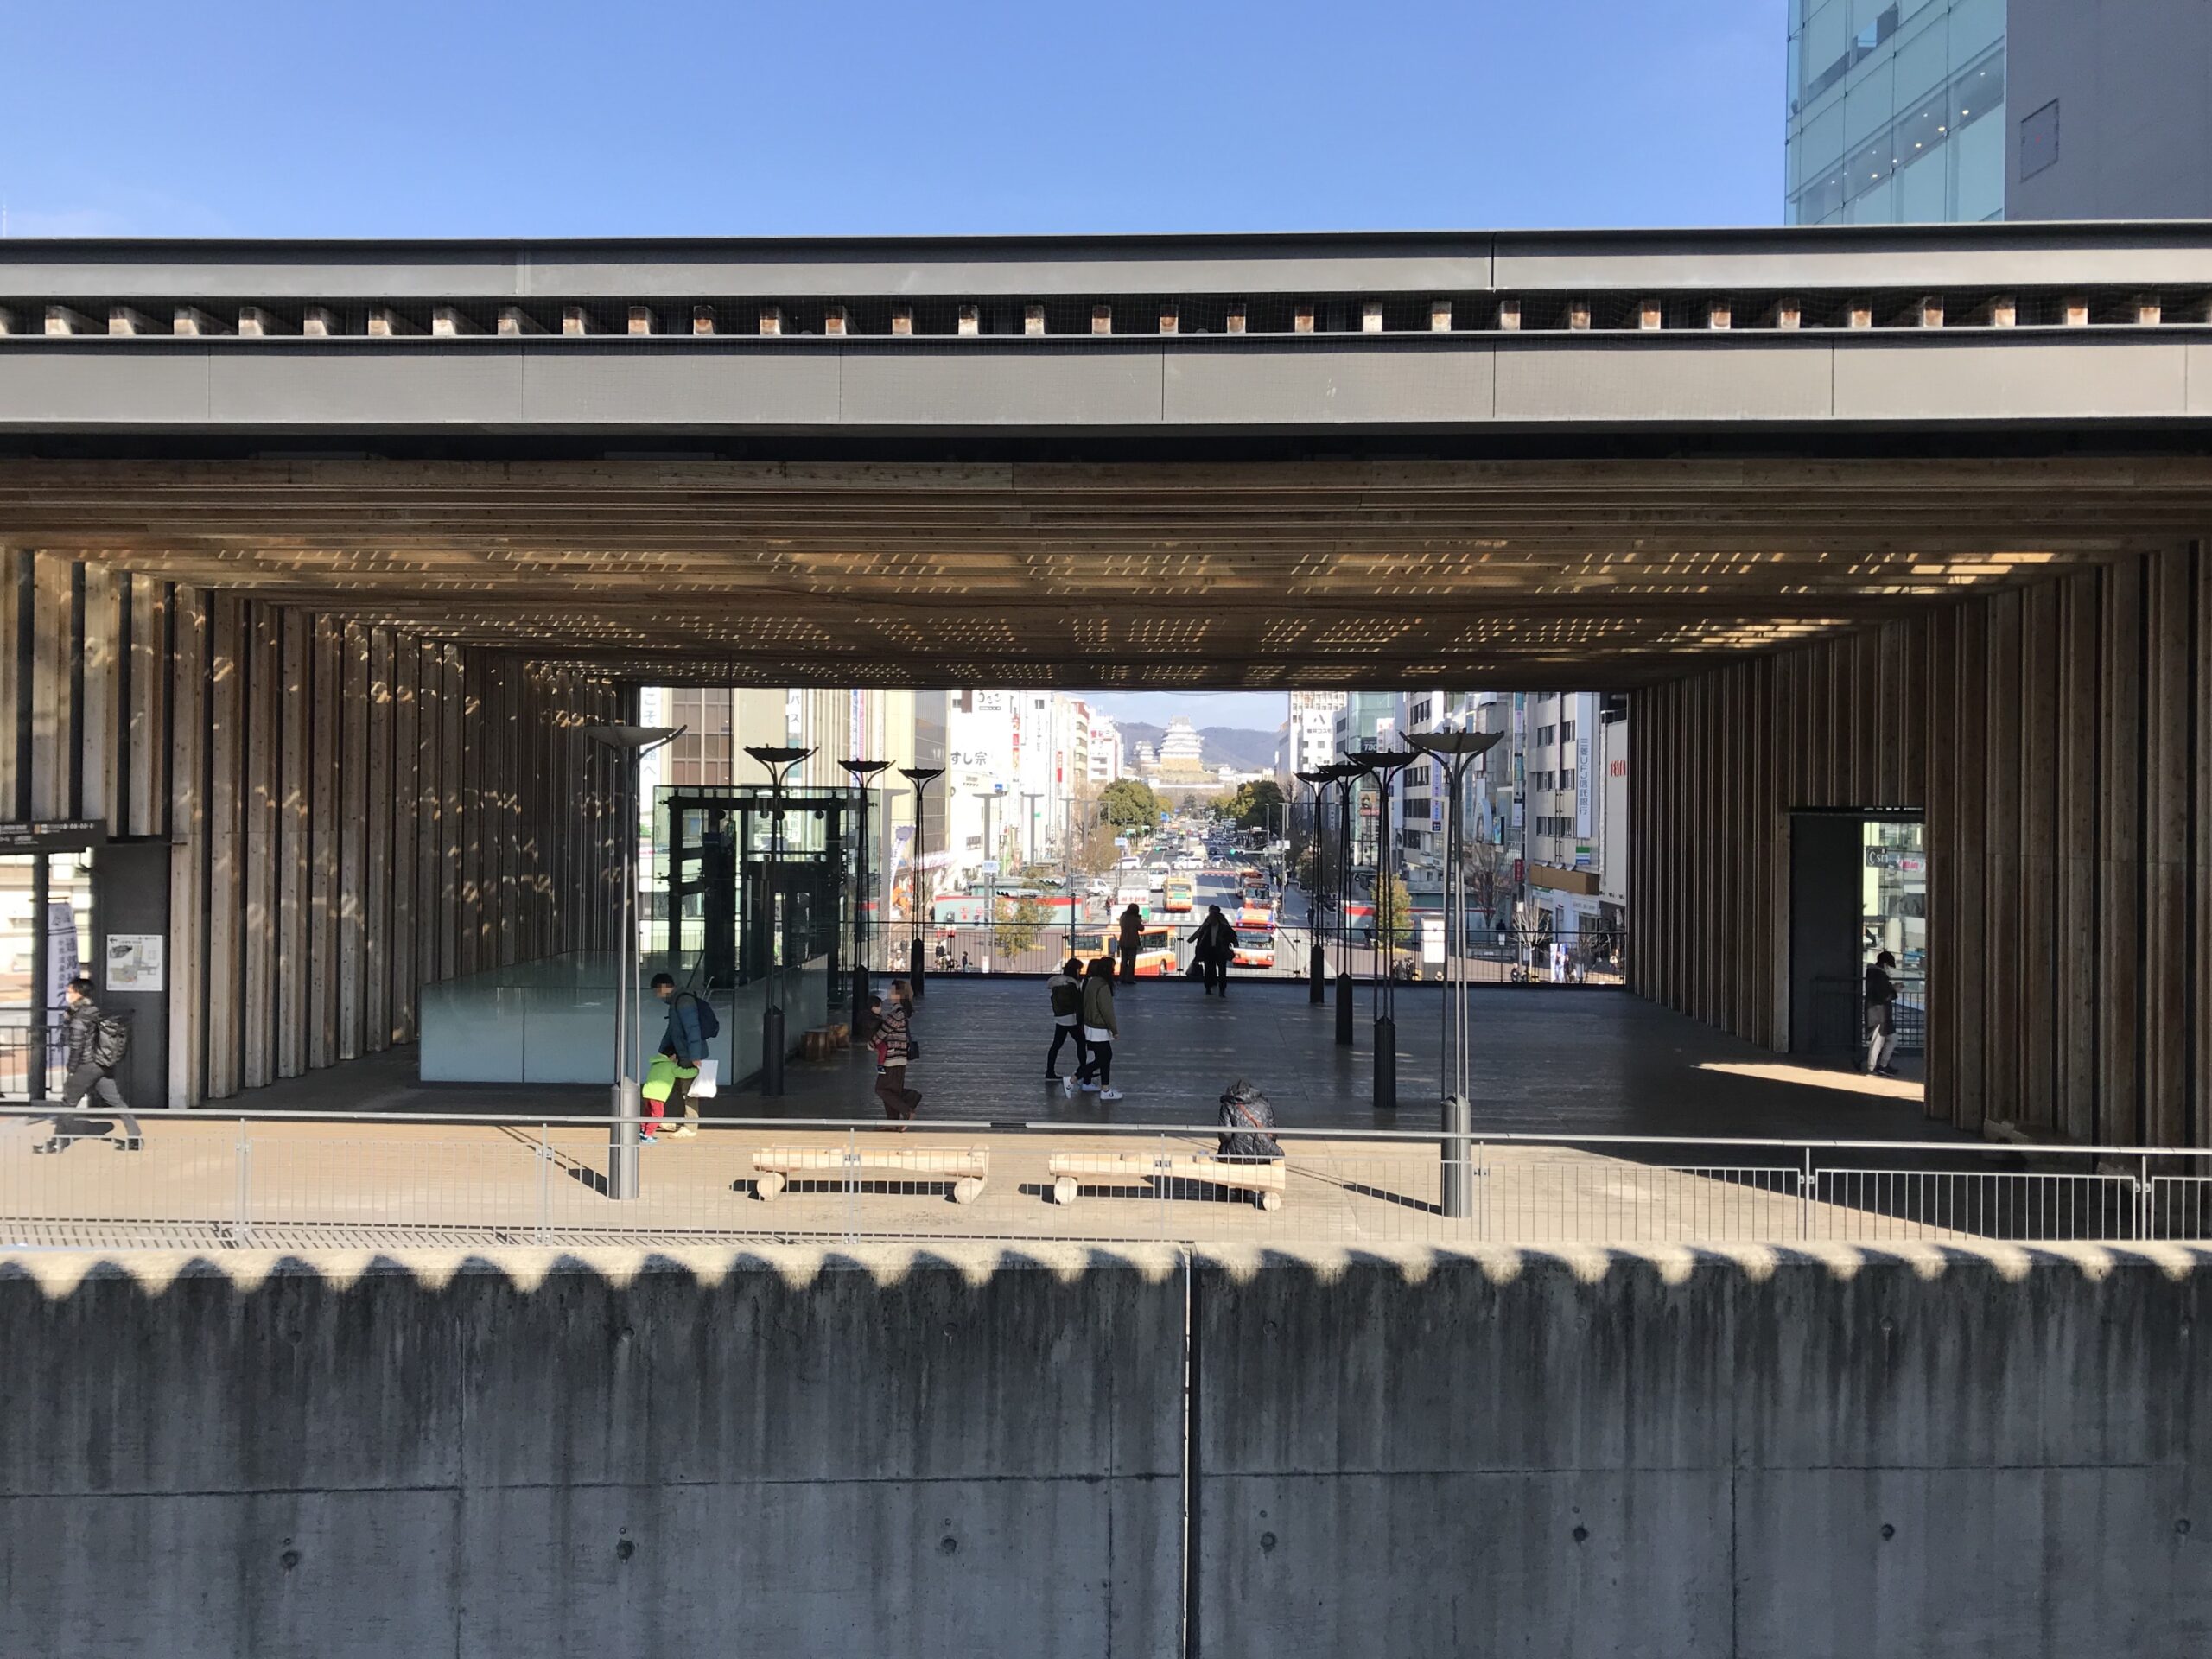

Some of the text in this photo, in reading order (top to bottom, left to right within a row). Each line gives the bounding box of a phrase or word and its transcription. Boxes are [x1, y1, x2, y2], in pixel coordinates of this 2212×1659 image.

[950, 751, 988, 766] すし宗
[1579, 738, 1589, 815] 三菱UFJ信託銀行
